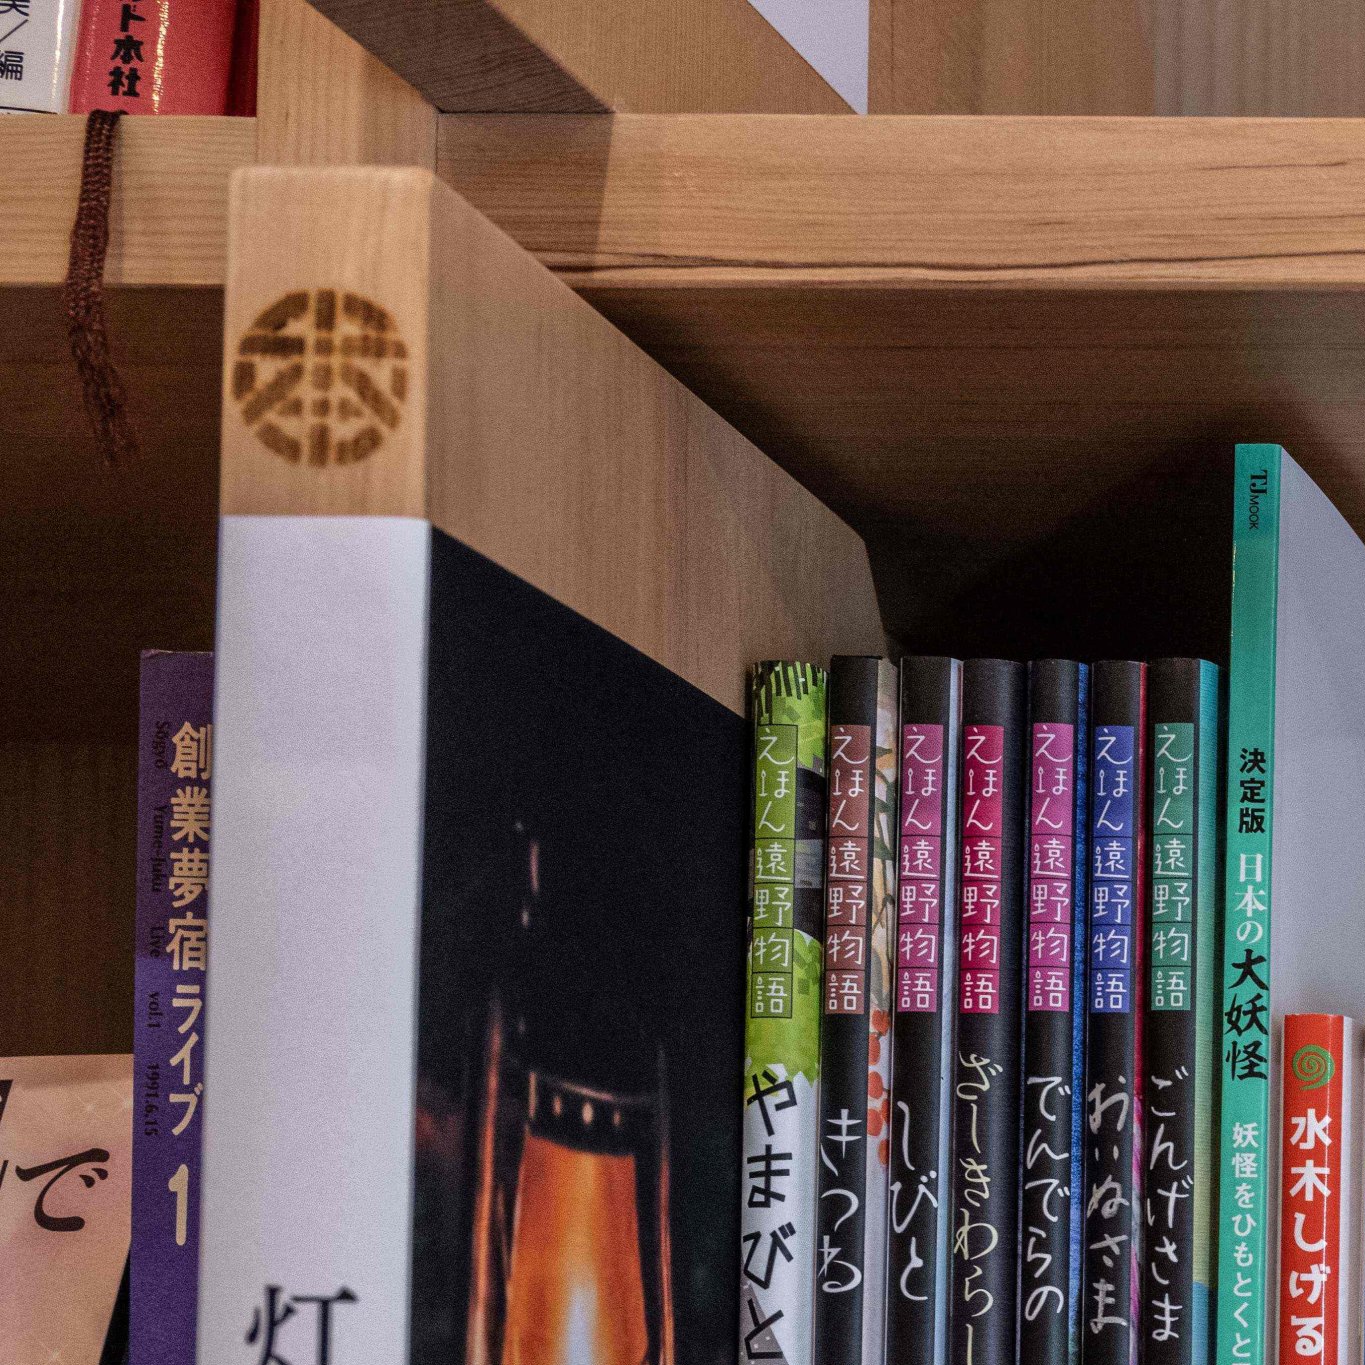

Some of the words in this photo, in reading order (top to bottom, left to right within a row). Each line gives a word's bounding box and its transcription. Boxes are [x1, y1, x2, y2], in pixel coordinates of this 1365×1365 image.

[108, 0, 146, 97] ド本社
[1238, 747, 1266, 834] 決定版
[0, 1148, 110, 1232] で
[743, 1069, 796, 1360] やまびと
[891, 1101, 938, 1301] しびと
